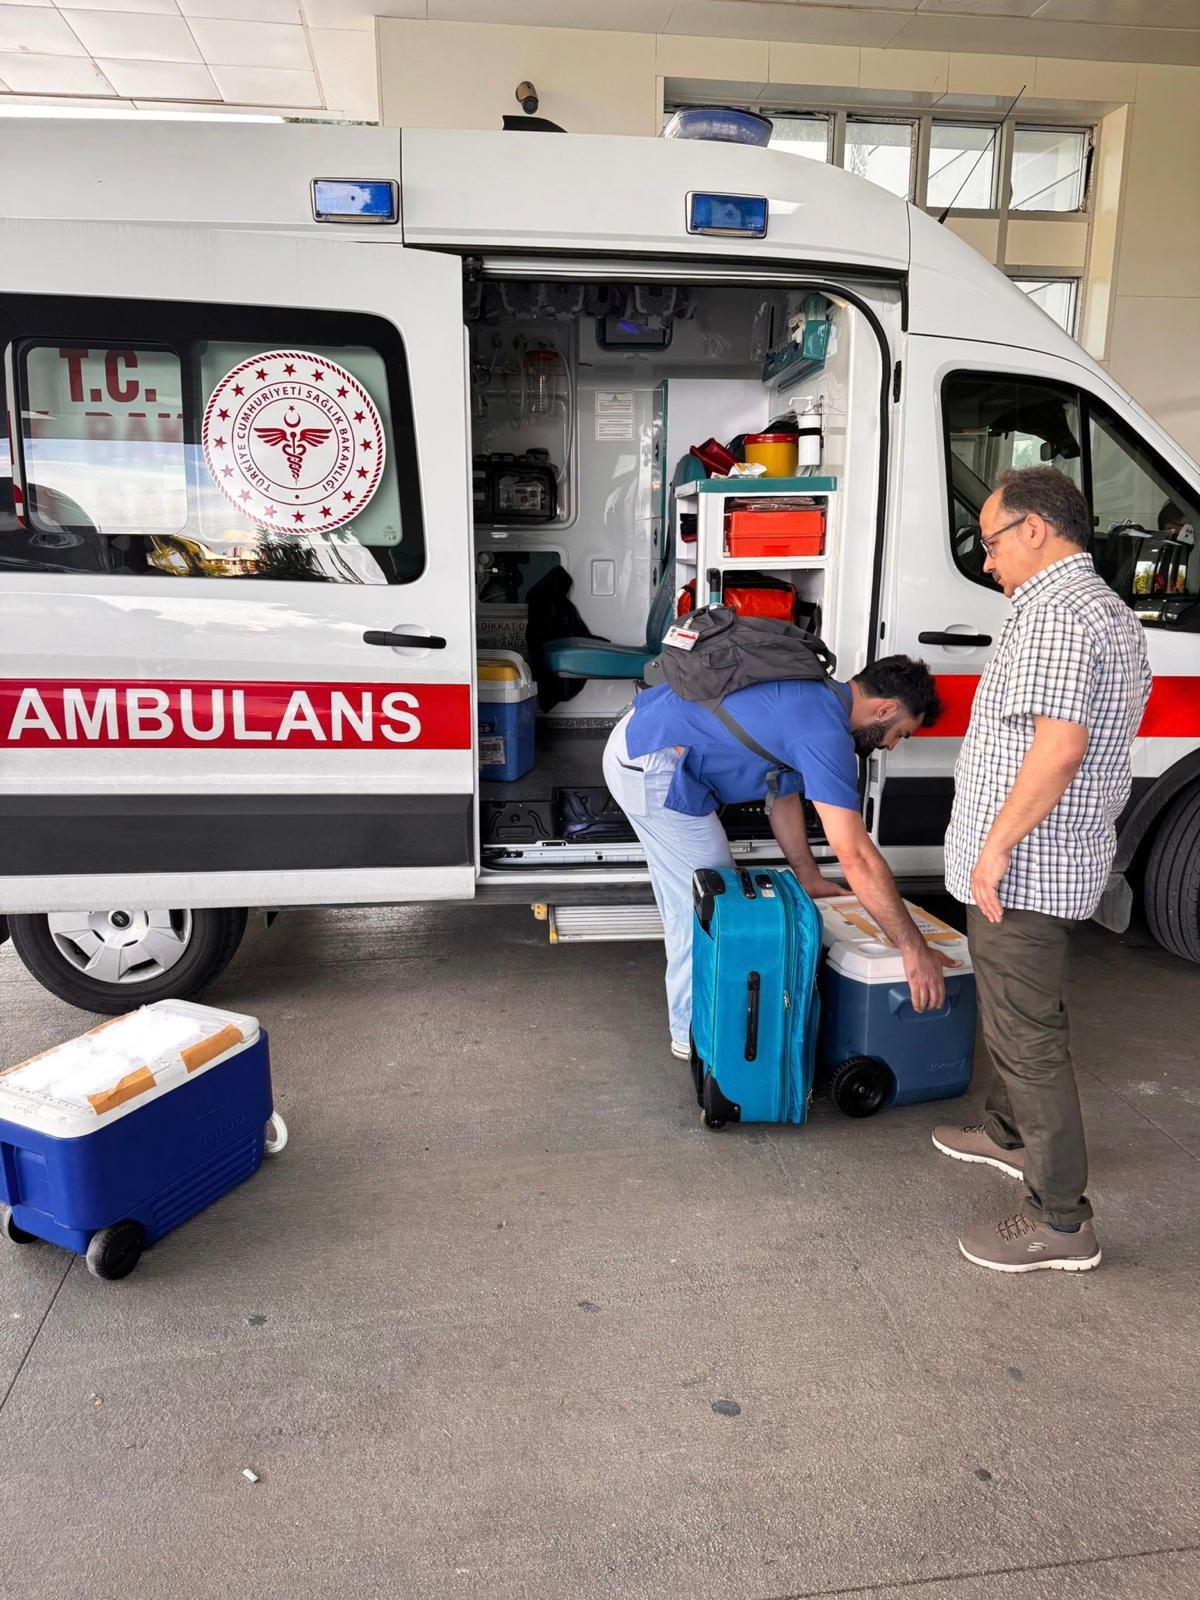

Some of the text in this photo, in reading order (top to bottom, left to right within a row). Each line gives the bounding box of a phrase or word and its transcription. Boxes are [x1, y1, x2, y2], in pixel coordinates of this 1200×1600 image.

[59, 348, 157, 403] T.C.
[237, 385, 302, 440] CUMHURİYETİ
[306, 389, 344, 425] SAĞLIK
[237, 444, 272, 493] TÜRKİYE
[321, 427, 351, 493] BAKANLIĞI
[7, 687, 422, 743] AMBULANS
